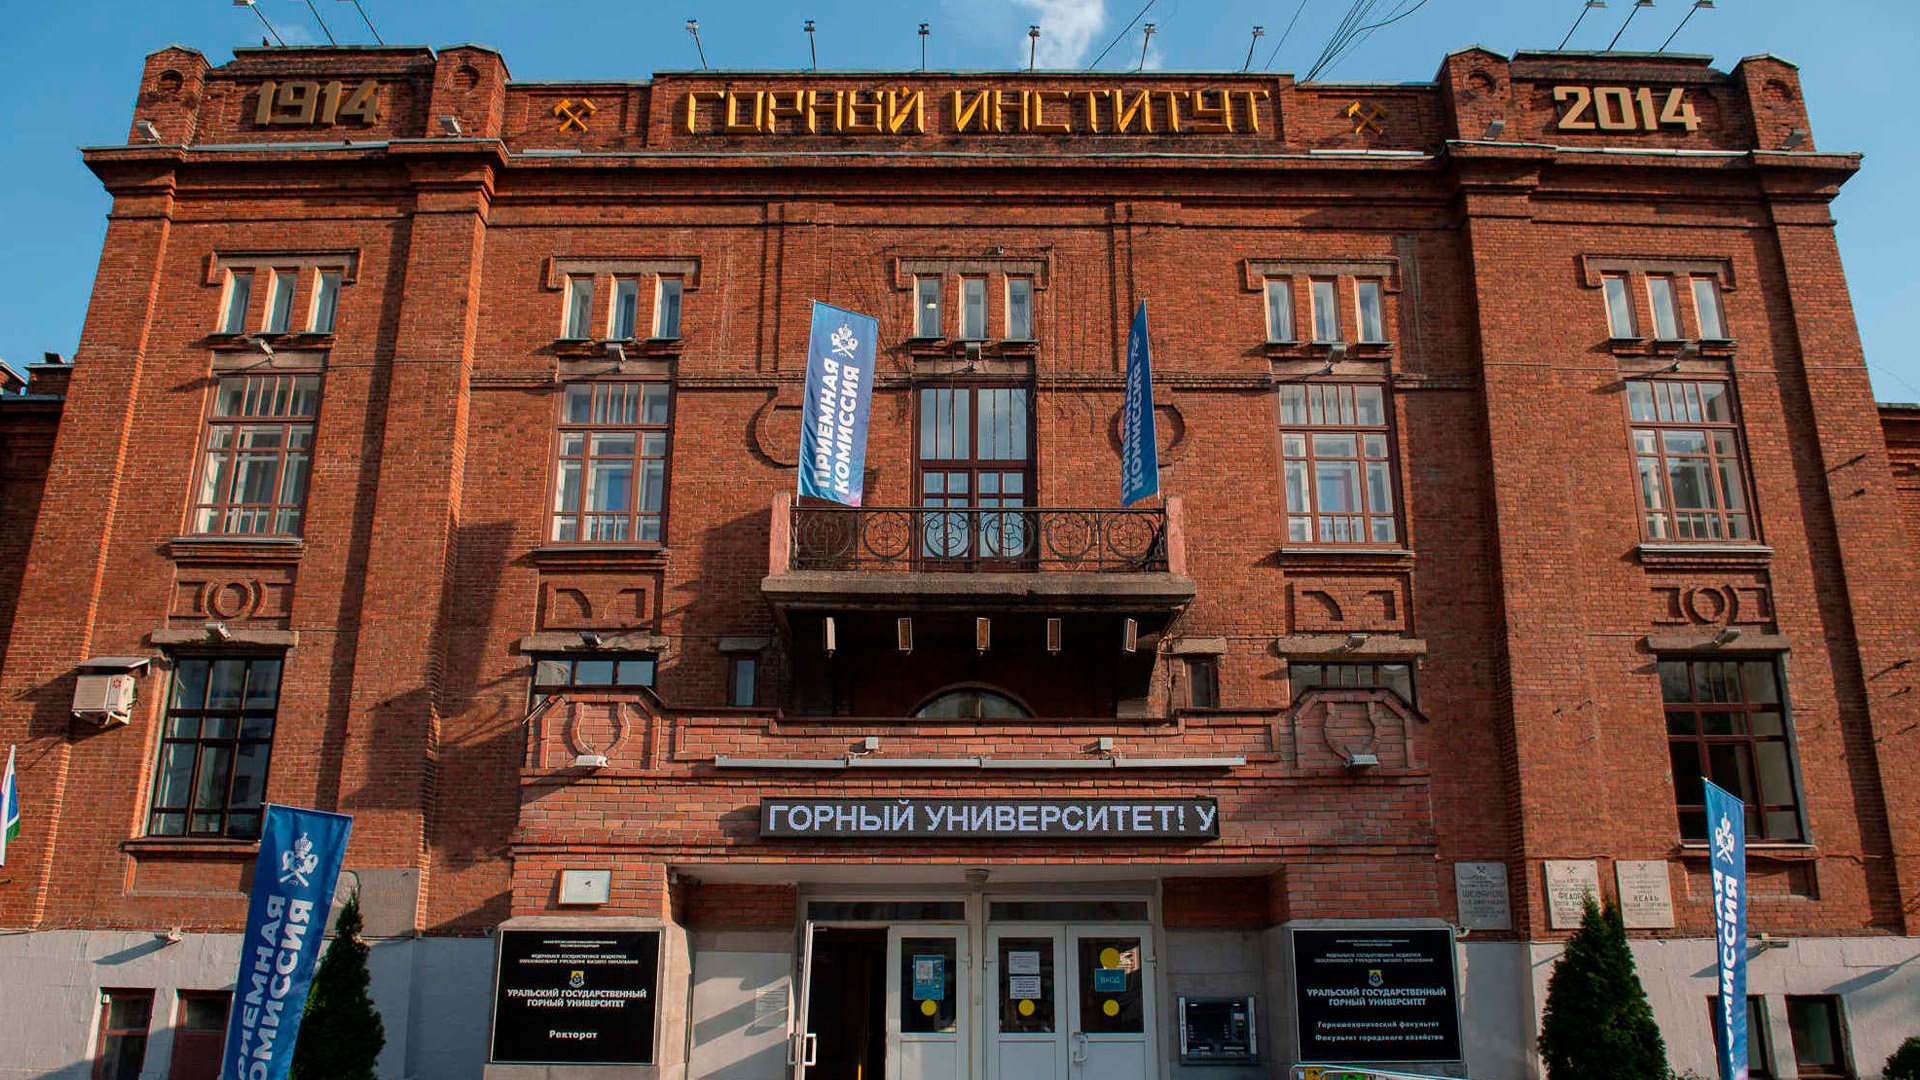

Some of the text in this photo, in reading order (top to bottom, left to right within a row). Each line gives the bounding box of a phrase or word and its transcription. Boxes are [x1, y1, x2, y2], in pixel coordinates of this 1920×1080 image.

[255, 79, 383, 125] 1914
[687, 87, 1269, 134] ГОРНЫЙ ИНСТИТУТ
[1553, 86, 1702, 131] 2014
[813, 357, 839, 488] ПРИЕМНАЯ
[834, 365, 860, 494] КОМИССИЯ
[1131, 361, 1144, 492] КОМИССИЯ
[769, 799, 914, 831] ГОРНЫЙ
[925, 805, 1185, 831] УНИВЕРСИТЕТ!
[237, 895, 286, 1080] РИЕМНАЯ
[250, 900, 313, 1080] ОМИССИЯ
[507, 988, 647, 998] УРАЛЬСКИЙ ГОСУДАРСТВЕННЫЙ
[1307, 987, 1446, 996] УРАЛЬСКИЙ ГОСУДАРСТВЕННЫЙ
[1722, 874, 1739, 1074] МИССИЯ
[527, 998, 625, 1008] ГОРНЫЙ УНИВЕРСИТЕТ
[1329, 996, 1426, 1006] ГОРНЫЙ УНИВЕРСИТЕТ
[549, 1030, 598, 1040] Ректорат
